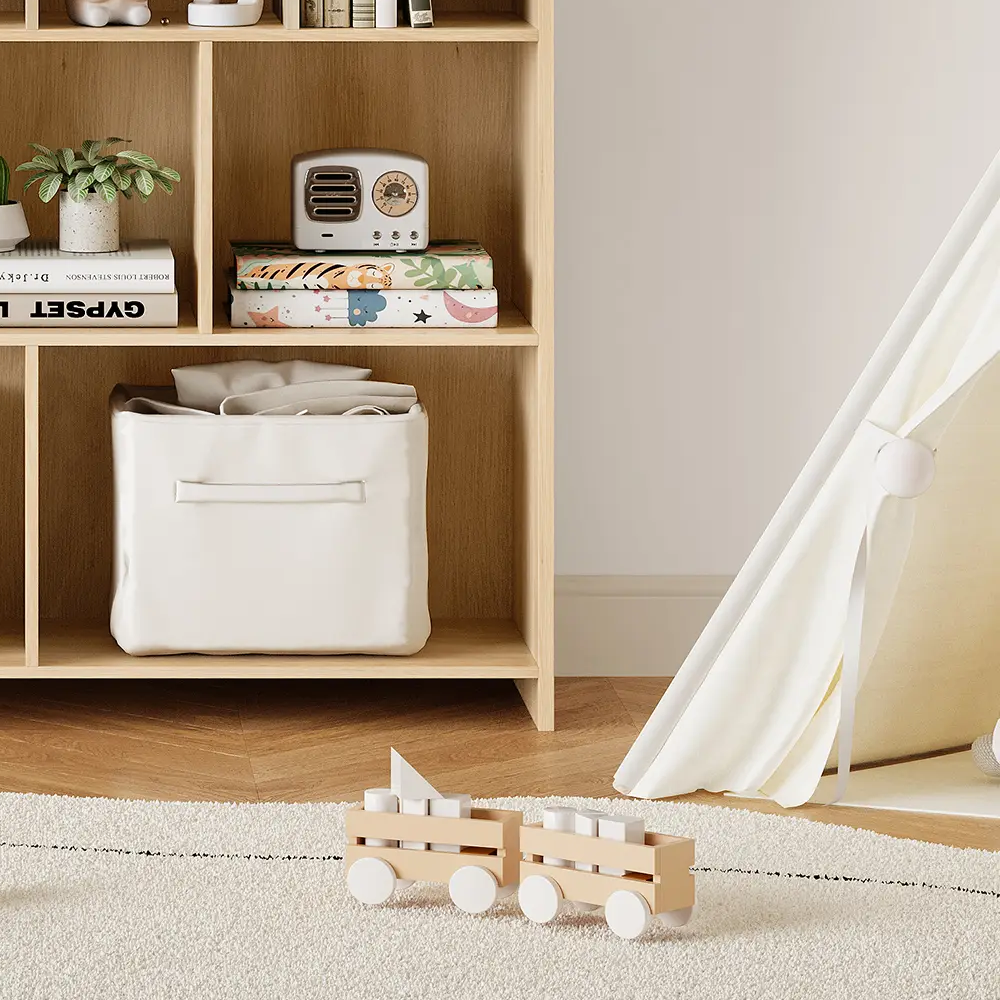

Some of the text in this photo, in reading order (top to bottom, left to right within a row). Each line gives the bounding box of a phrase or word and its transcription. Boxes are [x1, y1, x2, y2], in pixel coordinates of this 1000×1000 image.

[65, 273, 170, 281] ROBERT LOUIS STEVENSON
[30, 301, 145, 318] GYPSET
